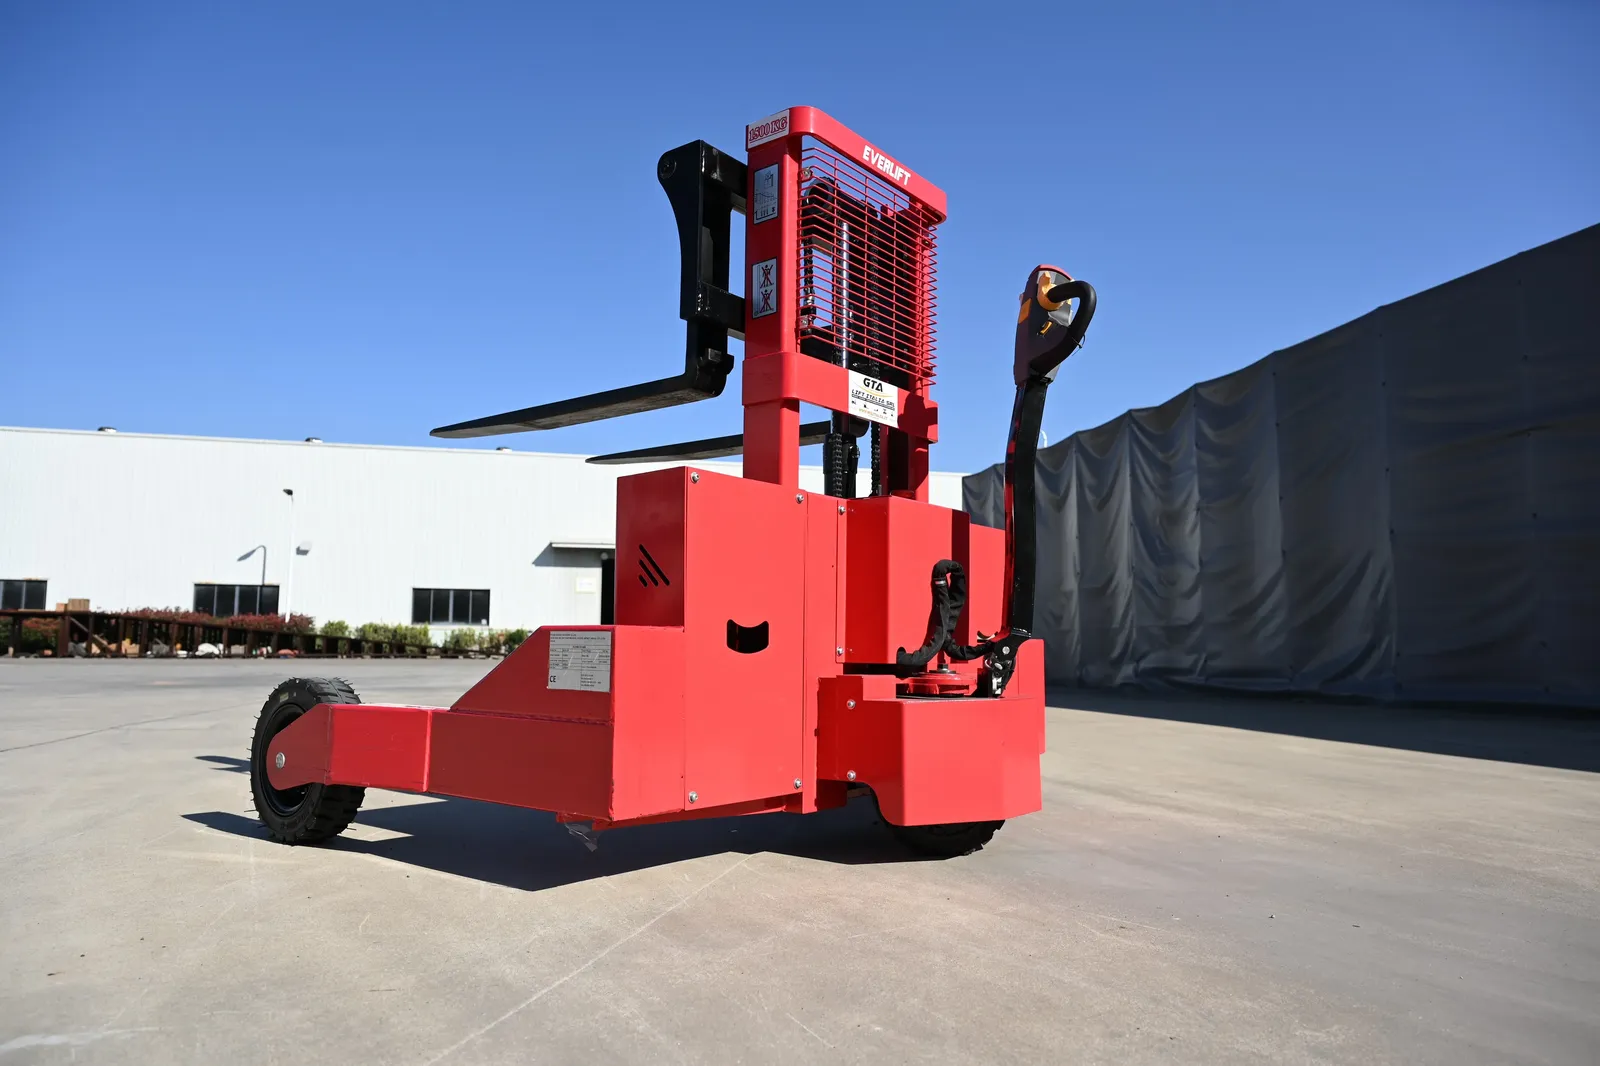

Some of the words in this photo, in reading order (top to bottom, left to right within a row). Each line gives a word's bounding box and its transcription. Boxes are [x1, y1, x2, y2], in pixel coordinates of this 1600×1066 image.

[749, 124, 771, 141] 1500
[771, 117, 788, 133] KG
[862, 145, 911, 186] EVERLIFT
[863, 377, 883, 392] GTA
